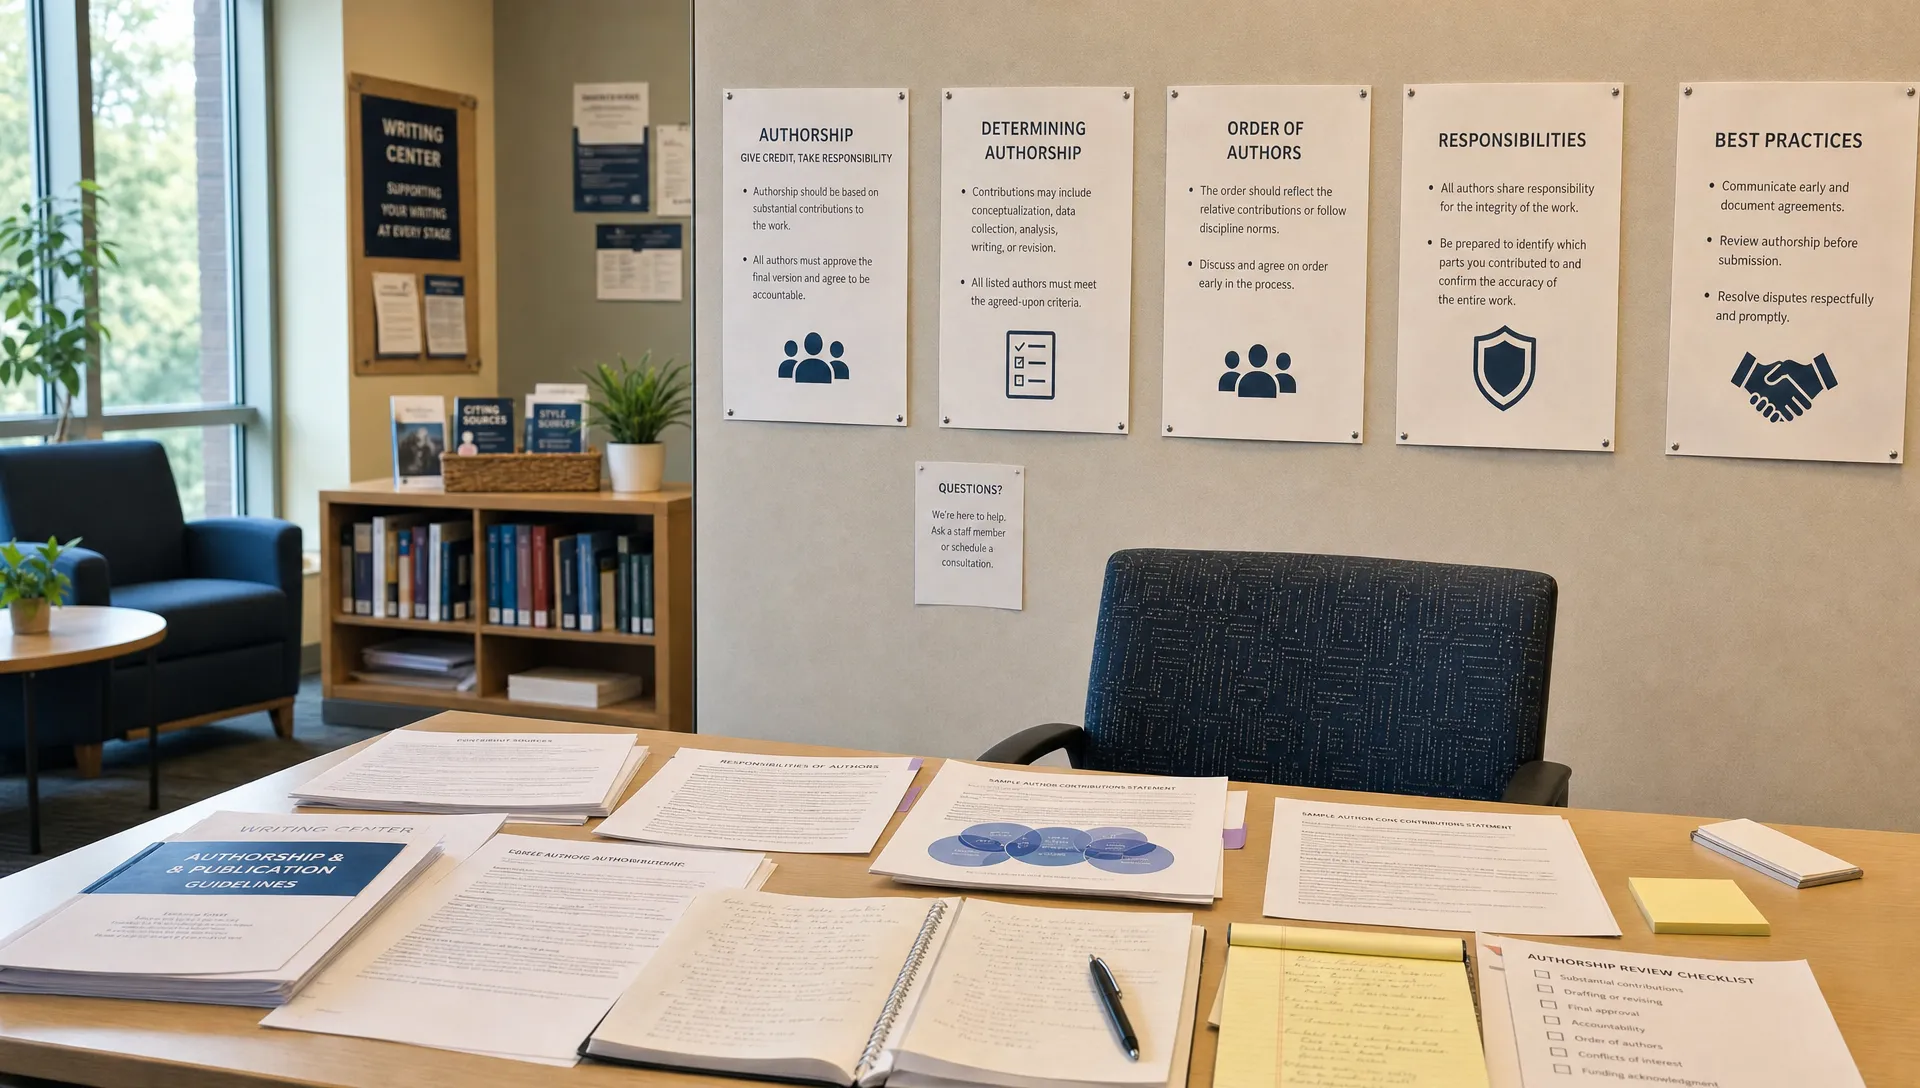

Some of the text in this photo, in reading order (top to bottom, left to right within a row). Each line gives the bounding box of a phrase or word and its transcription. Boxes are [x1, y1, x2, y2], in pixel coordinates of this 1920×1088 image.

[382, 118, 443, 143] WRITING
[759, 127, 853, 142] AUTHORSHIP
[982, 121, 1085, 135] DETERMINING
[1227, 121, 1303, 135] ORDER OF
[1439, 132, 1586, 147] RESPONSIBILITIES
[1715, 132, 1862, 148] BEST PRACTICES
[385, 144, 441, 167] CENTER
[740, 152, 892, 163] GIVE CREDIT, TAKE RESPONSIBILITY
[984, 145, 1081, 160] AUTHORSHIP
[1226, 145, 1301, 160] AUTHORS
[753, 186, 878, 198] Authorship should be based on
[972, 186, 1091, 199] Contributions may include
[1200, 185, 1332, 196] The order should reflect the
[1440, 182, 1595, 196] All authors share responsibility
[1722, 180, 1849, 195] Communicate early and
[753, 203, 863, 214] substantial contributions to
[971, 205, 1075, 217] conceptualization, data
[1200, 203, 1346, 215] relative contributions or follow
[1720, 199, 1844, 214] document agreements.
[752, 220, 790, 230] the work.
[971, 223, 1058, 237] collection, analysis,
[1199, 222, 1279, 236] discipline norms.
[971, 241, 1056, 254] writing, or revision.
[1440, 237, 1586, 252] Be prepared to identify which
[1720, 235, 1858, 250] Review authorship before
[752, 254, 872, 268] All authors must approve the
[1439, 257, 1581, 270] parts you contributed to and
[1718, 254, 1781, 266] submission.
[971, 277, 1097, 289] All listed authors must meet
[1438, 275, 1557, 290] confirm the accuracy of
[752, 289, 805, 300] accountable.
[1718, 290, 1874, 307] Resolve disputes respectfully
[971, 295, 1081, 309] the agreed-upon criteria.
[1715, 310, 1789, 325] and promptly.
[938, 482, 1002, 495] QUESTIONS?
[931, 510, 1006, 523] We're here to help.
[931, 526, 945, 535] Ask
[953, 526, 971, 536] staff
[973, 527, 1006, 537] member
[951, 542, 986, 552] schedule
[941, 558, 993, 568] consultation.
[184, 852, 345, 862] AUTHORSHIP &
[166, 865, 337, 875] & PUBLICATION
[184, 880, 299, 889] GUIDELINES
[1528, 953, 1754, 984] AUTHORSHIP REVIEW CHECKLIST
[1560, 974, 1683, 993] Substantial contributions
[1622, 996, 1663, 1006] revising
[1567, 1003, 1639, 1016] Final approval
[1571, 1019, 1645, 1034] Accountability
[1574, 1035, 1604, 1043] Order
[1622, 1041, 1663, 1050] authors
[1578, 1051, 1625, 1061] Conflicts
[1641, 1057, 1683, 1067] interest
[1581, 1067, 1625, 1080] Funding
